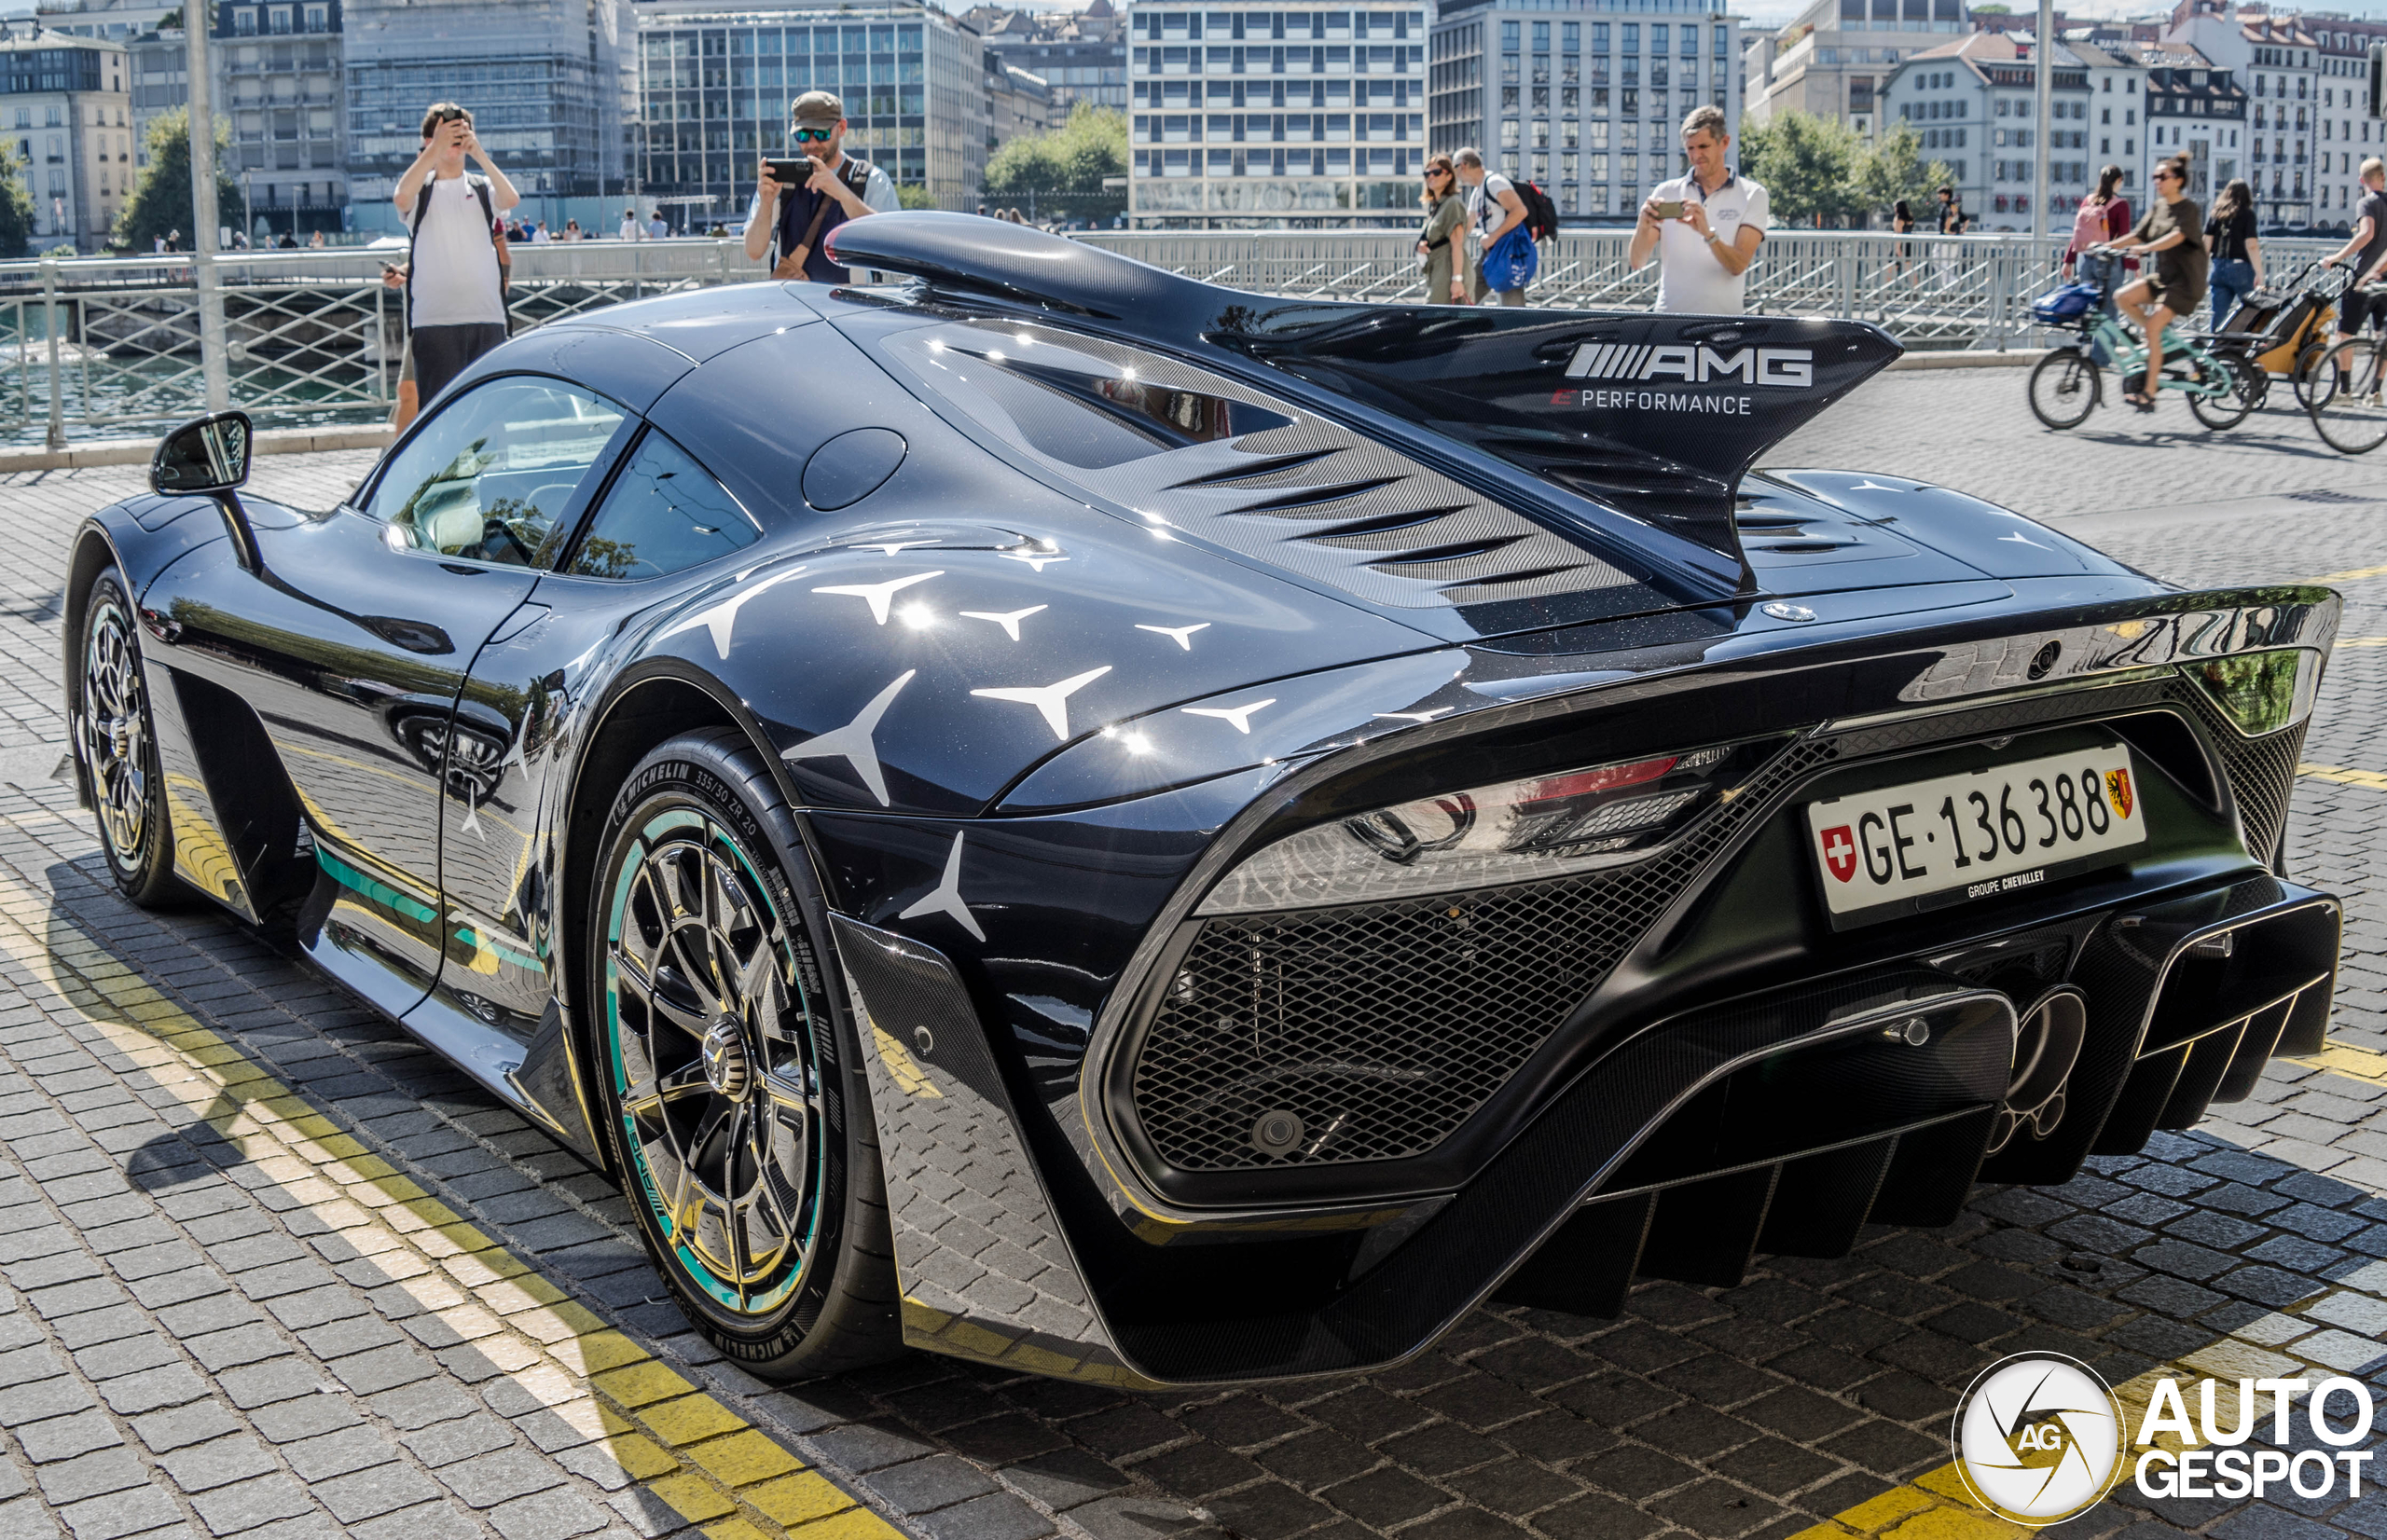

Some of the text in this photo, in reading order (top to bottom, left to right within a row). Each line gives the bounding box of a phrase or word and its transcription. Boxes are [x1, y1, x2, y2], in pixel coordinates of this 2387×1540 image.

[1638, 345, 1813, 387] AMG
[1582, 390, 1751, 415] PERFORMANCE
[628, 763, 757, 836] MICHELIN 335/30 ZR 20
[1968, 870, 2044, 898] GROUPE CHEVALLEY
[791, 938, 803, 968] EXTRA
[799, 970, 812, 998] LOAD
[673, 1295, 693, 1319] CUP
[714, 1333, 785, 1360] MICHELIN
